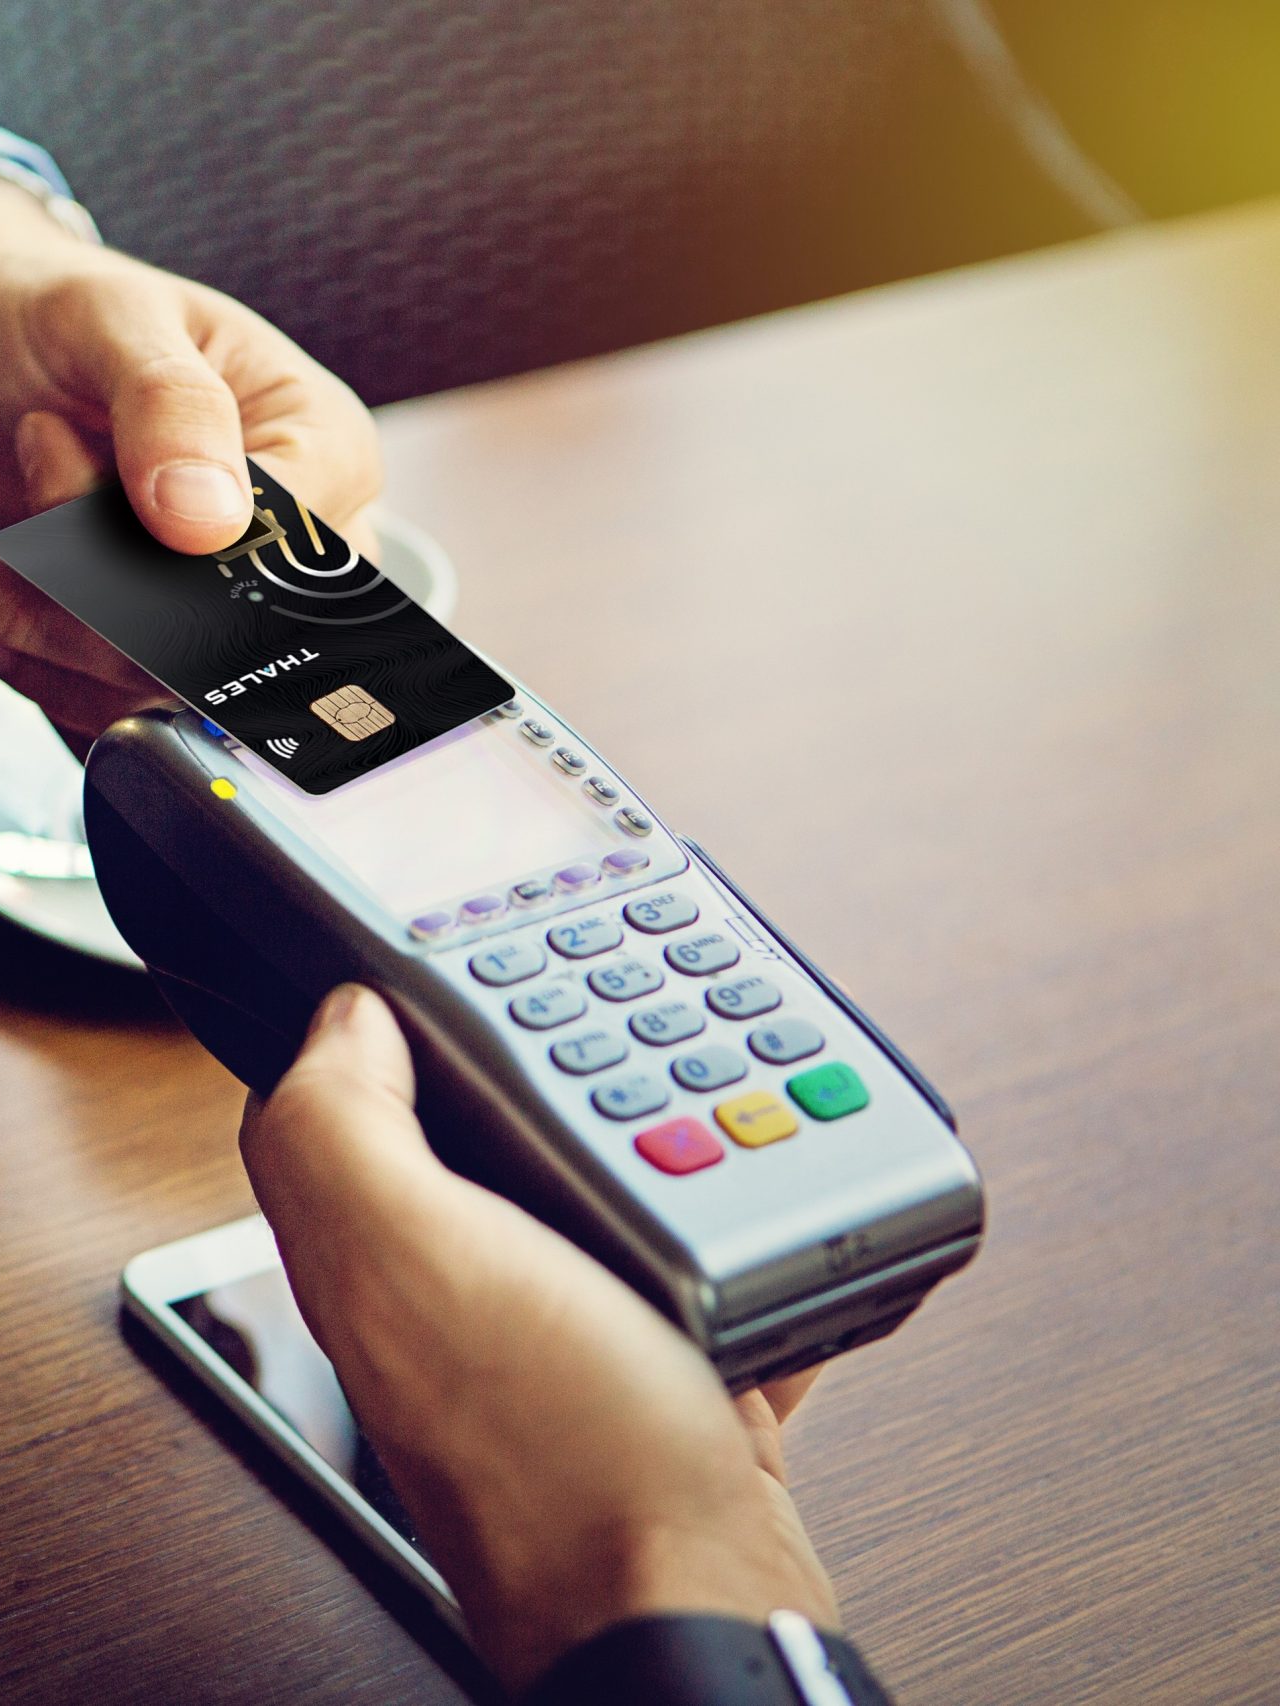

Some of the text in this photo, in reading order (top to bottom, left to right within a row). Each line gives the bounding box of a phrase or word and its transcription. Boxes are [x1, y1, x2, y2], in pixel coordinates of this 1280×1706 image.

[230, 580, 259, 599] STATUS
[204, 648, 320, 705] THALES
[635, 893, 676, 921] 3 DEF
[560, 927, 587, 947] 2
[486, 953, 506, 970] 1
[676, 944, 701, 963] 6
[601, 968, 625, 989] 5
[528, 998, 549, 1013] 4
[718, 987, 743, 1006] 9
[642, 1013, 667, 1033] 8
[684, 1057, 709, 1079] 0
